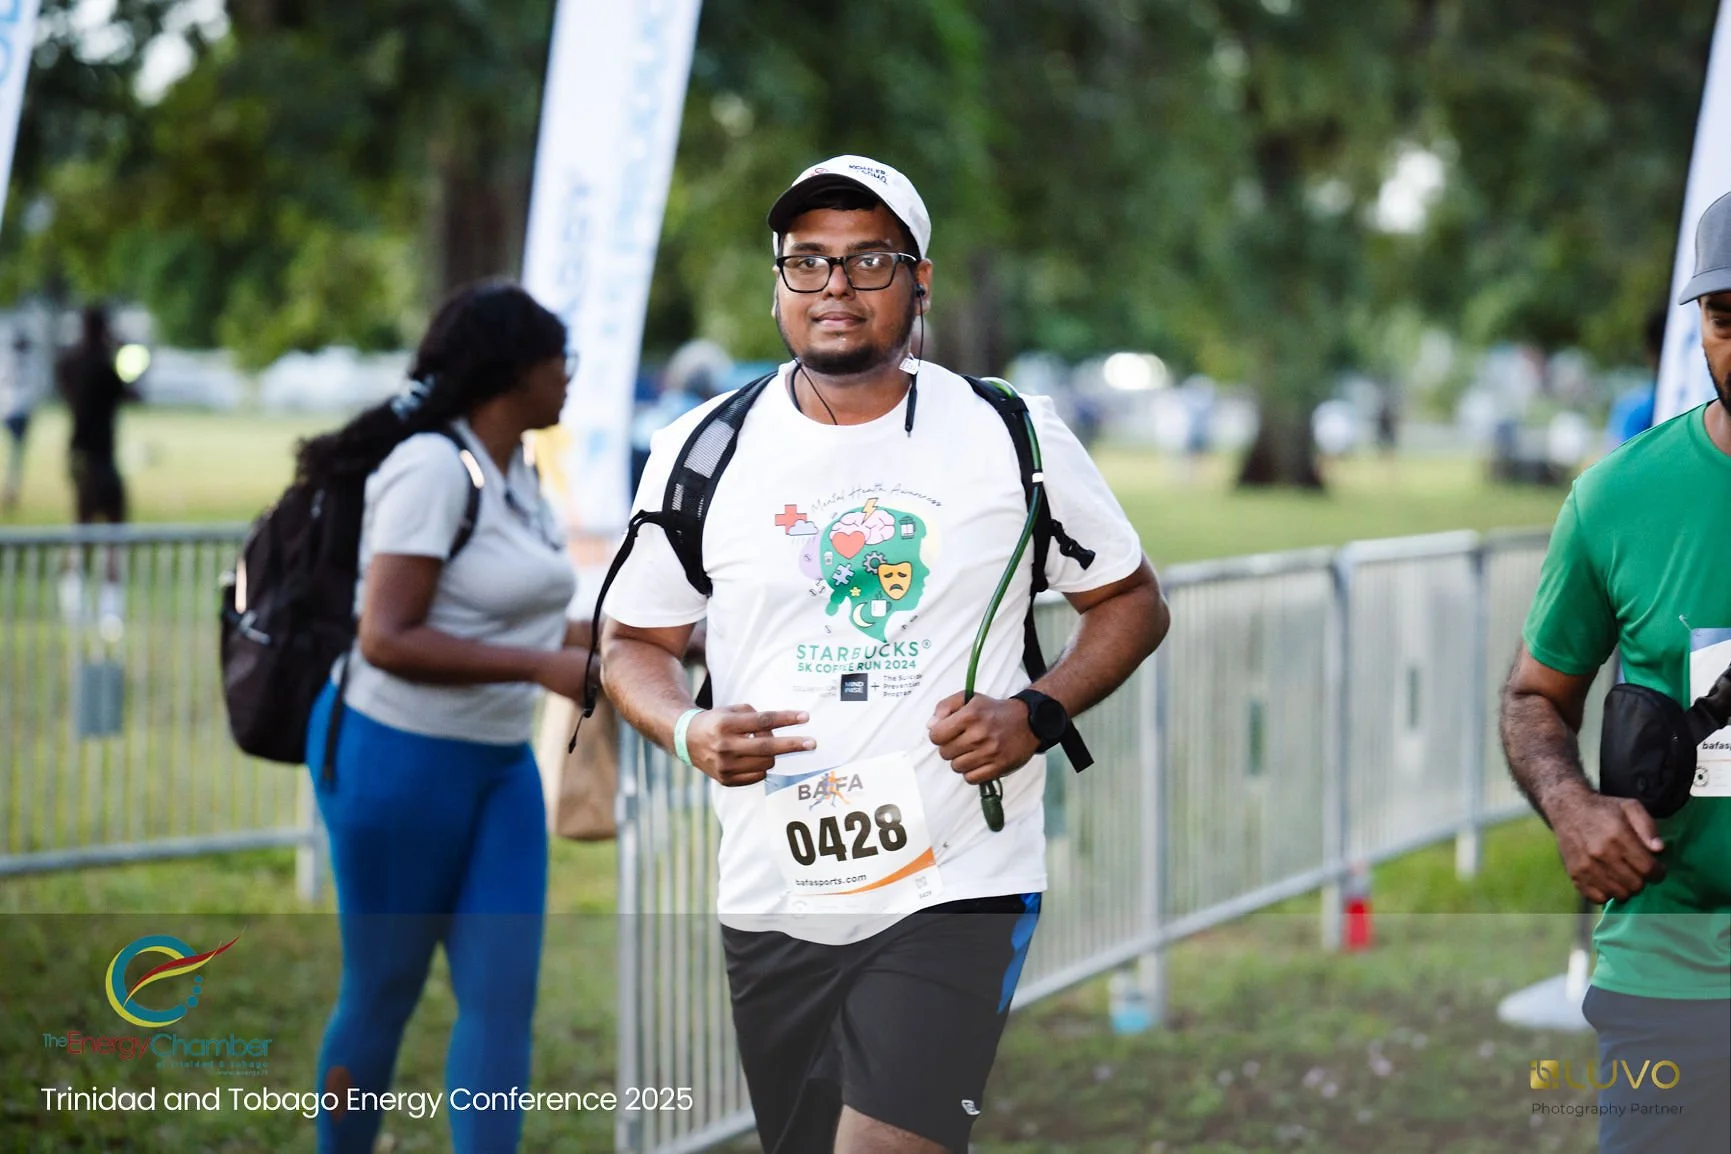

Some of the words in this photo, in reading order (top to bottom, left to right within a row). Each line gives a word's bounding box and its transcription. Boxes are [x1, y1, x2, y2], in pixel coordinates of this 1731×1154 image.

[796, 641, 919, 661] STARBUCKS
[797, 662, 813, 673] 5K
[856, 660, 881, 672] RUN
[884, 659, 917, 670] 2024
[1702, 741, 1731, 751] bafas
[786, 803, 908, 866] 0428
